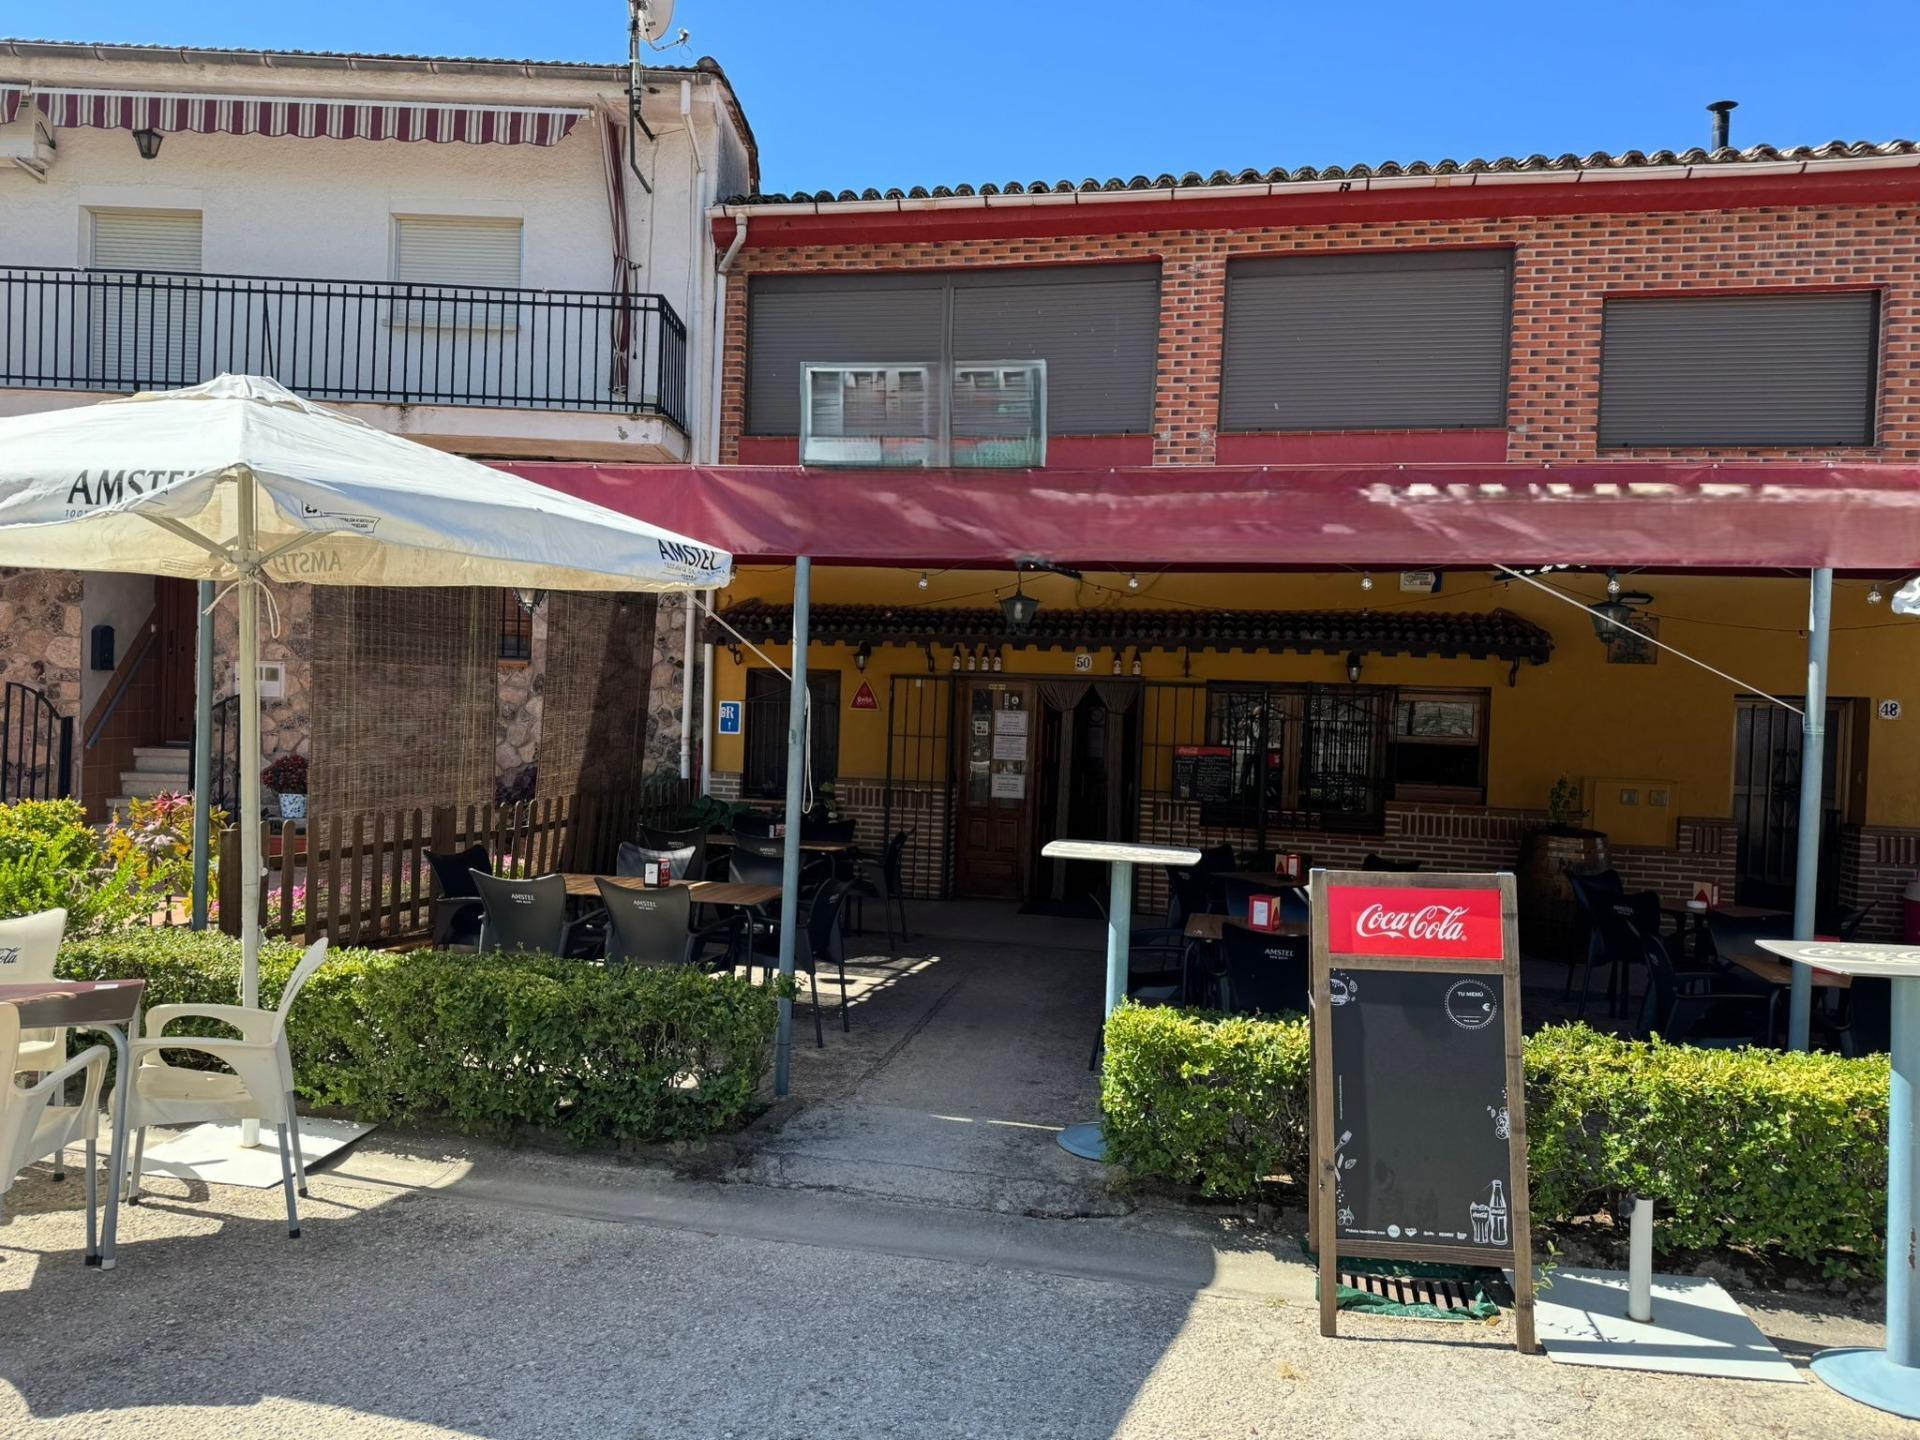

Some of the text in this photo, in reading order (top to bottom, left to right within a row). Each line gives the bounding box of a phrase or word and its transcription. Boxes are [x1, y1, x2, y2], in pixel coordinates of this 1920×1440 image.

[657, 538, 722, 571] AMSTEL
[1076, 655, 1090, 669] 50
[1880, 702, 1898, 717] 48
[511, 893, 536, 901] AMSTEL
[633, 899, 657, 907] AMSTEL
[1356, 903, 1470, 940] Coca-Cola
[1264, 948, 1295, 957] AMSTEL
